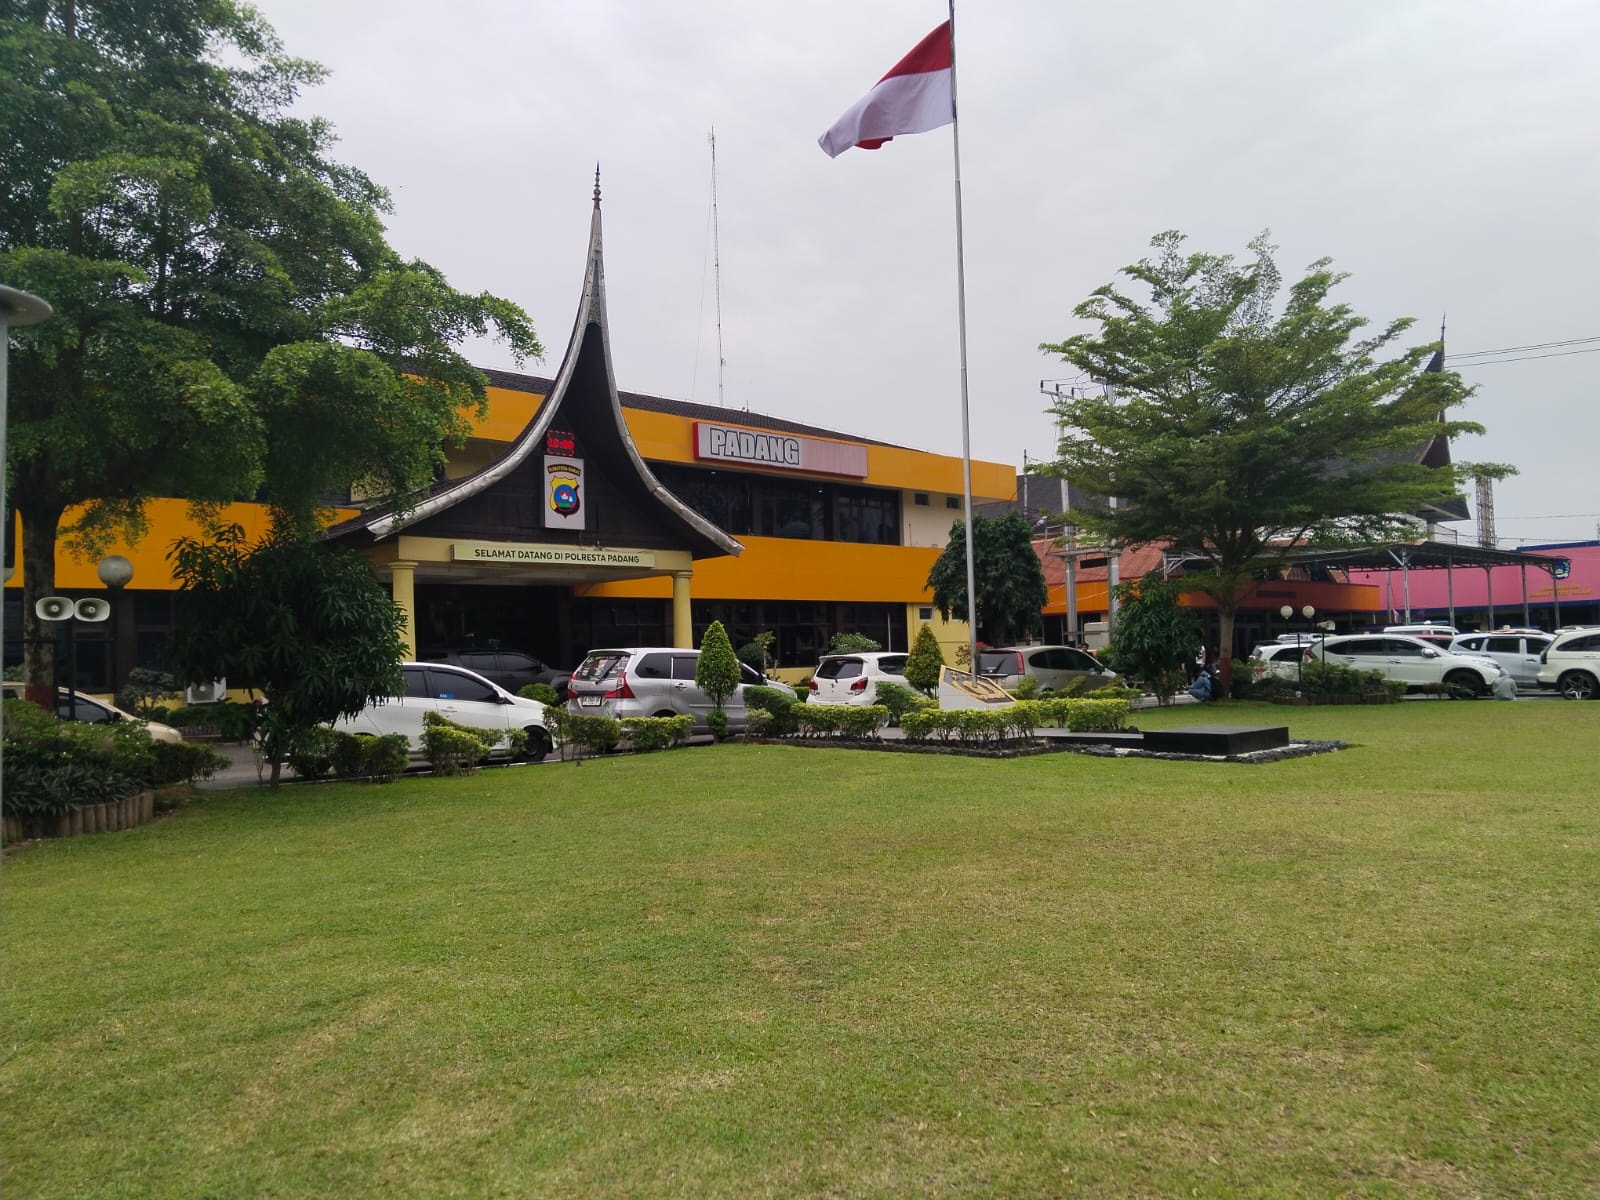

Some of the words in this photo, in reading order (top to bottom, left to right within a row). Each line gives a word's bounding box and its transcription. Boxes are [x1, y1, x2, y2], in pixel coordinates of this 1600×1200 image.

[710, 427, 800, 466] PADANG
[474, 549, 516, 559] SELAMAT
[518, 551, 553, 560] DATANG
[554, 552, 563, 560] DI
[565, 553, 606, 562] POLRESTA
[607, 554, 640, 563] PADANG
